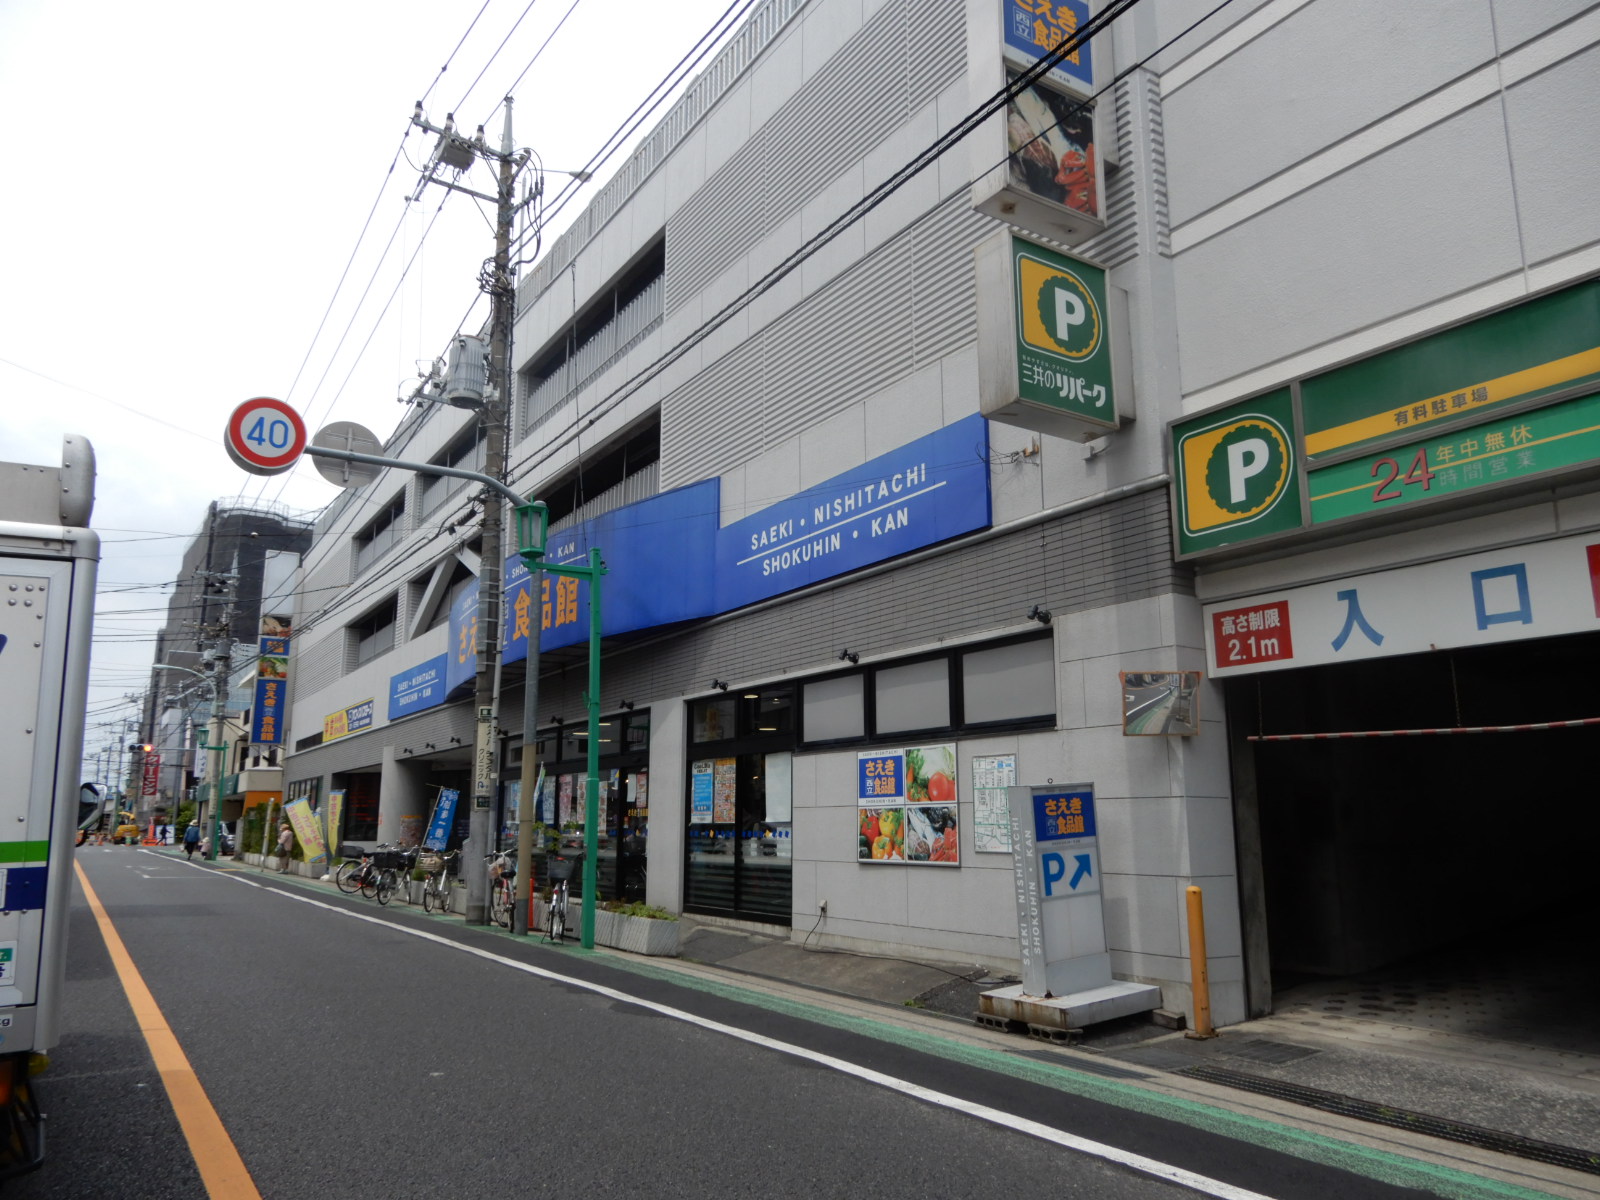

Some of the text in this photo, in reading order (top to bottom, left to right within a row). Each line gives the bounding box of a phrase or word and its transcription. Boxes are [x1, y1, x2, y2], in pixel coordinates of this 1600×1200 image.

[1055, 287, 1086, 342] P
[1022, 362, 1106, 408] 三井のリパーク
[1394, 386, 1489, 426] 有料駐車場
[247, 417, 289, 448] 40
[1436, 424, 1533, 463] 年中無休
[1227, 438, 1270, 504] P
[1370, 447, 1536, 503] 24 時間営業
[751, 463, 927, 551] SAEKI NISHITACHI
[558, 542, 575, 558] KAN
[762, 507, 909, 576] SHOKUHIN KAN
[1221, 608, 1280, 636] 高さ制限
[1331, 562, 1533, 652] 入口
[458, 616, 478, 664] さえ
[1228, 636, 1279, 661] 2.1m
[865, 759, 895, 776] さえき
[873, 776, 896, 794] 食品館
[1044, 797, 1082, 816] さえき
[1056, 815, 1085, 834] 食品館
[1012, 817, 1031, 967] SAEKI NISHITACHI
[1025, 830, 1041, 954] SHOKUHIN KAN
[1042, 852, 1065, 897] P
